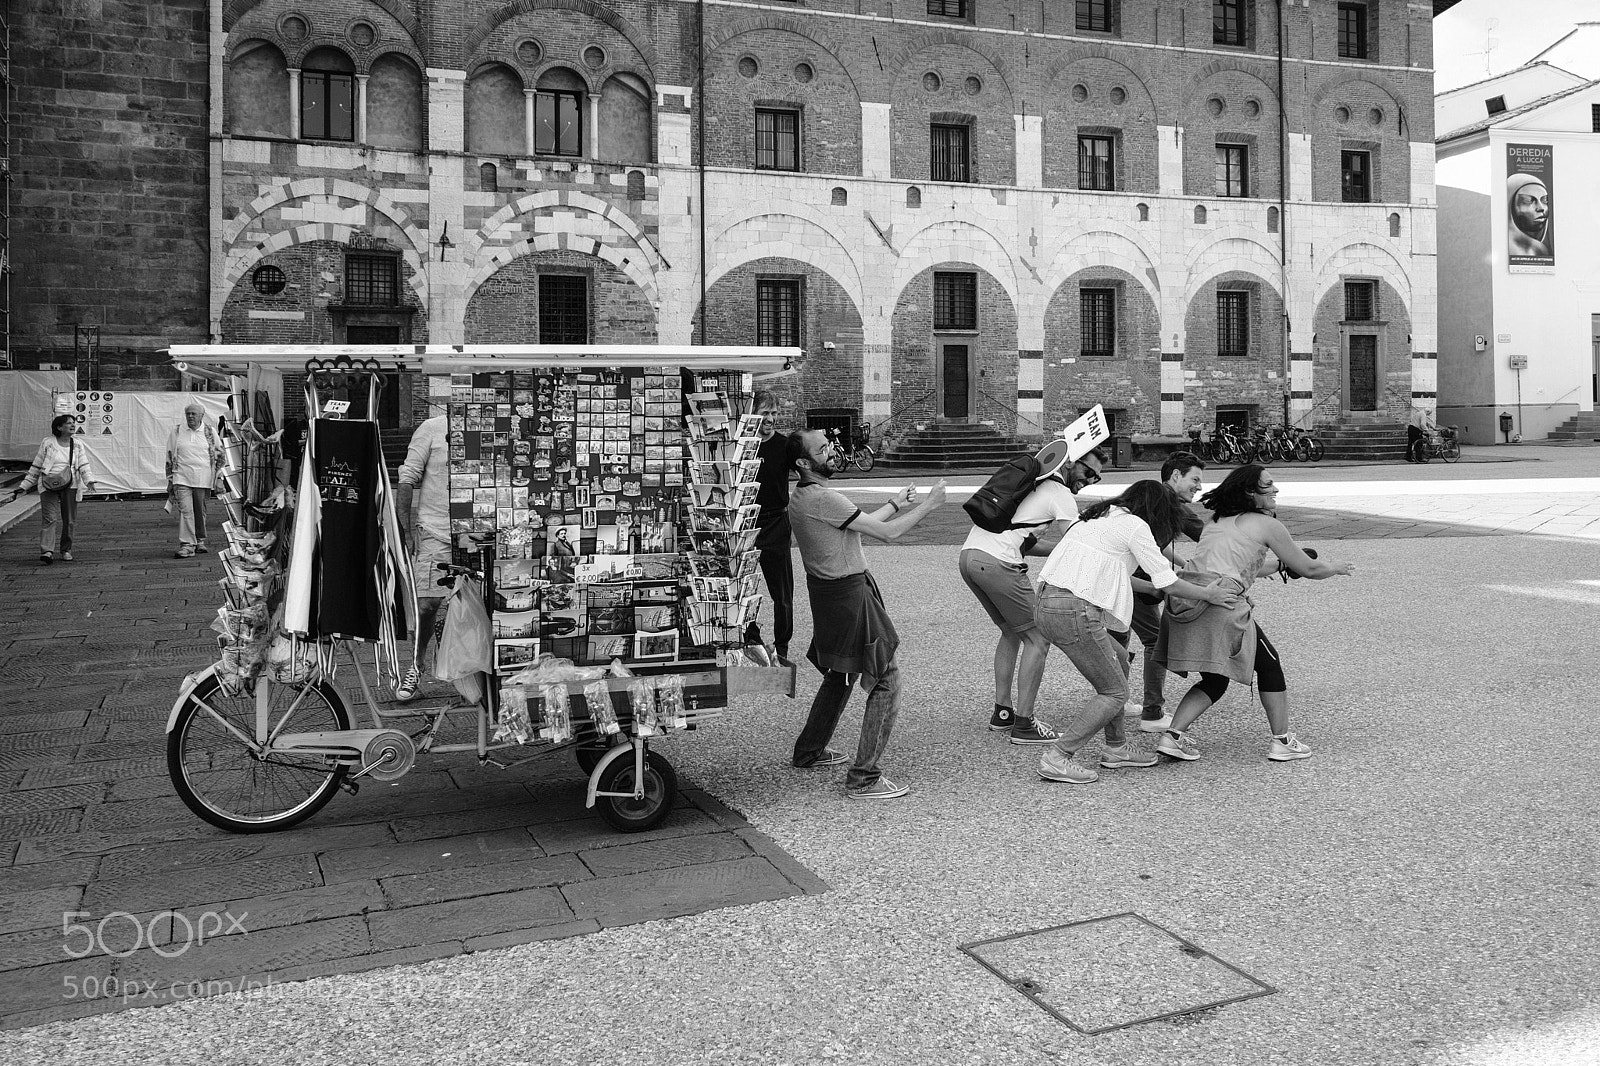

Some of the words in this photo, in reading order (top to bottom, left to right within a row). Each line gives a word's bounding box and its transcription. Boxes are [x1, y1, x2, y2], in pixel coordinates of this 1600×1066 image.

[1509, 147, 1551, 158] DEREDIA
[1087, 411, 1102, 440] TEAM
[1073, 431, 1086, 442] 4
